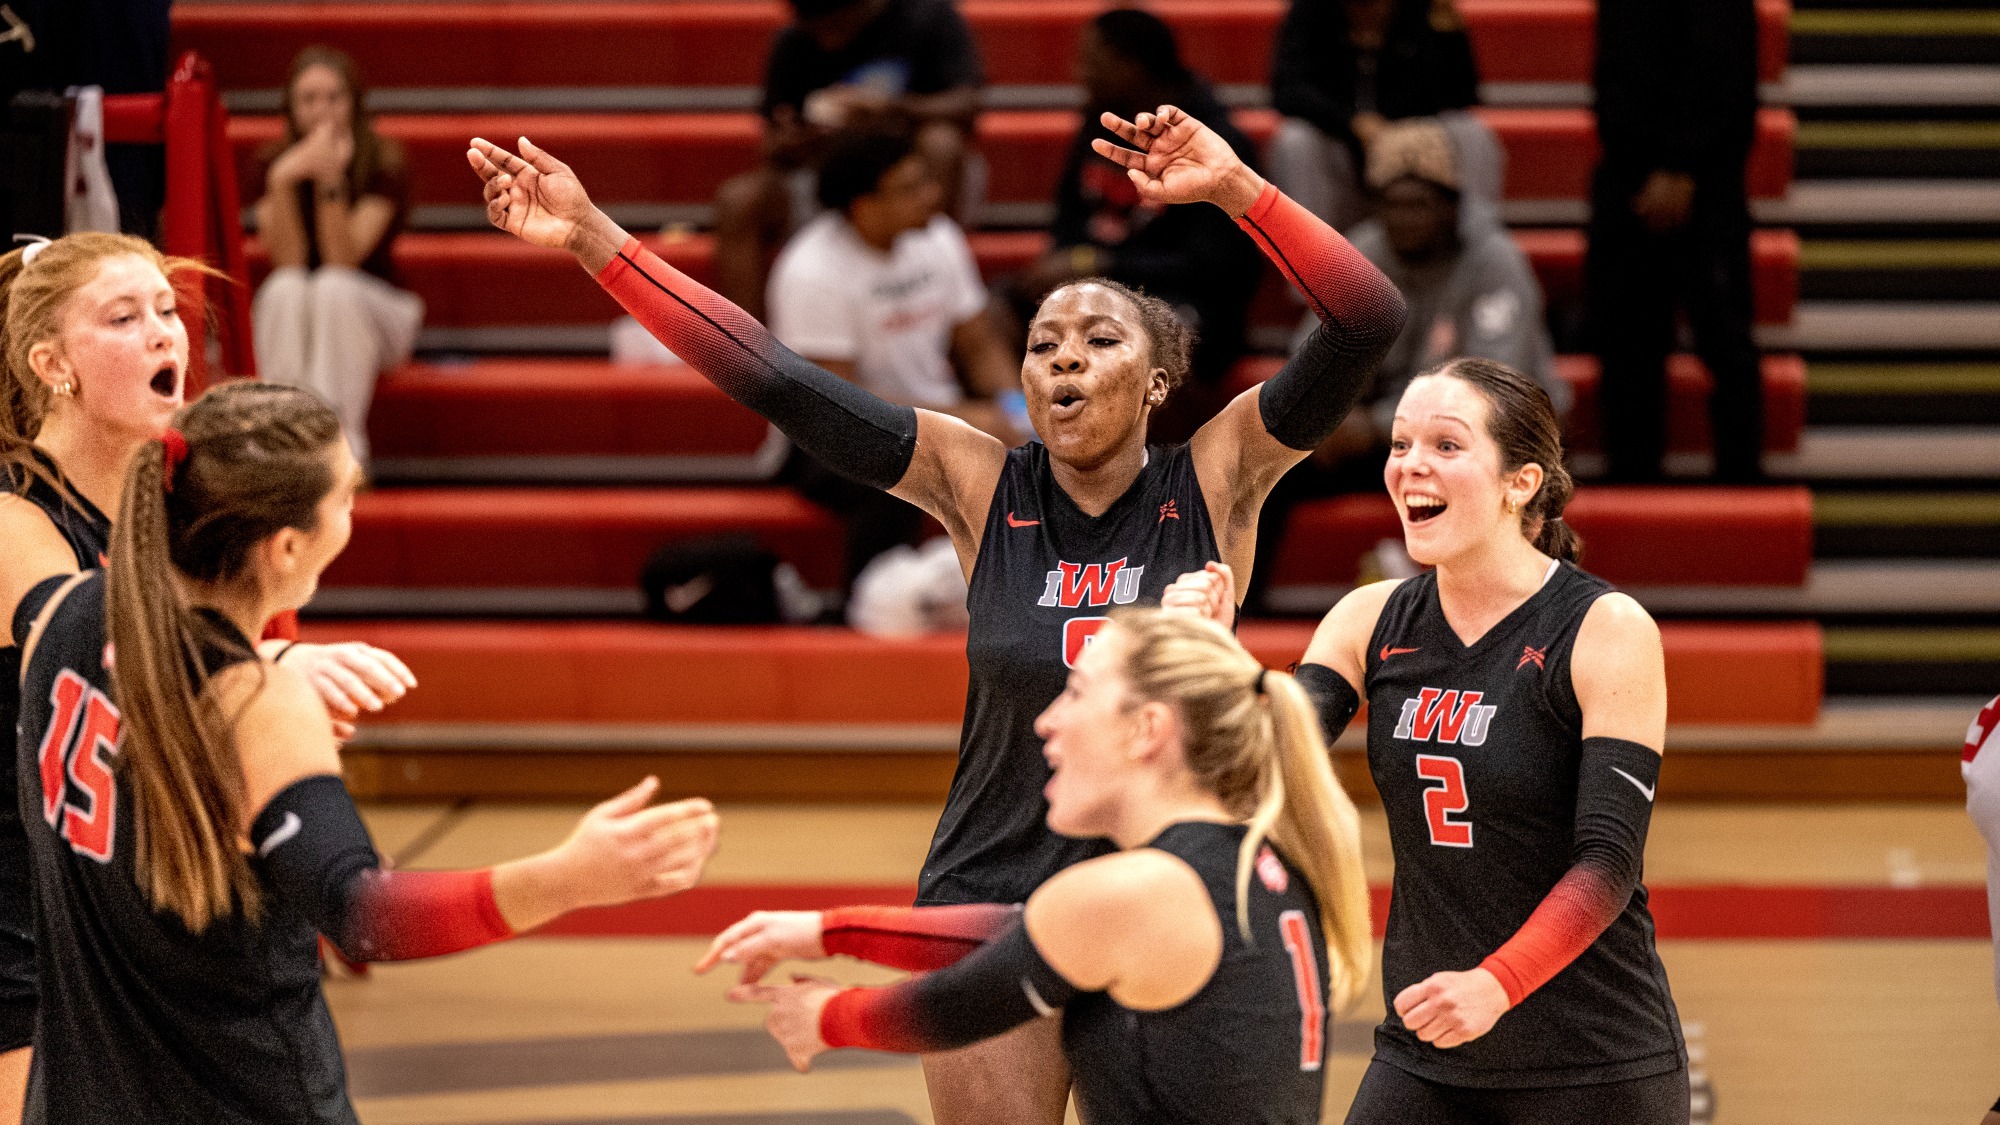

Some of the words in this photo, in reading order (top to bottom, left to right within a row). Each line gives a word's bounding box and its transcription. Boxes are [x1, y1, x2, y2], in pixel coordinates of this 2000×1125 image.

[1037, 556, 1145, 608] IWU
[1393, 687, 1498, 746] IWU
[38, 667, 122, 863] 15
[1416, 753, 1474, 848] 2
[1278, 909, 1325, 1071] 1
